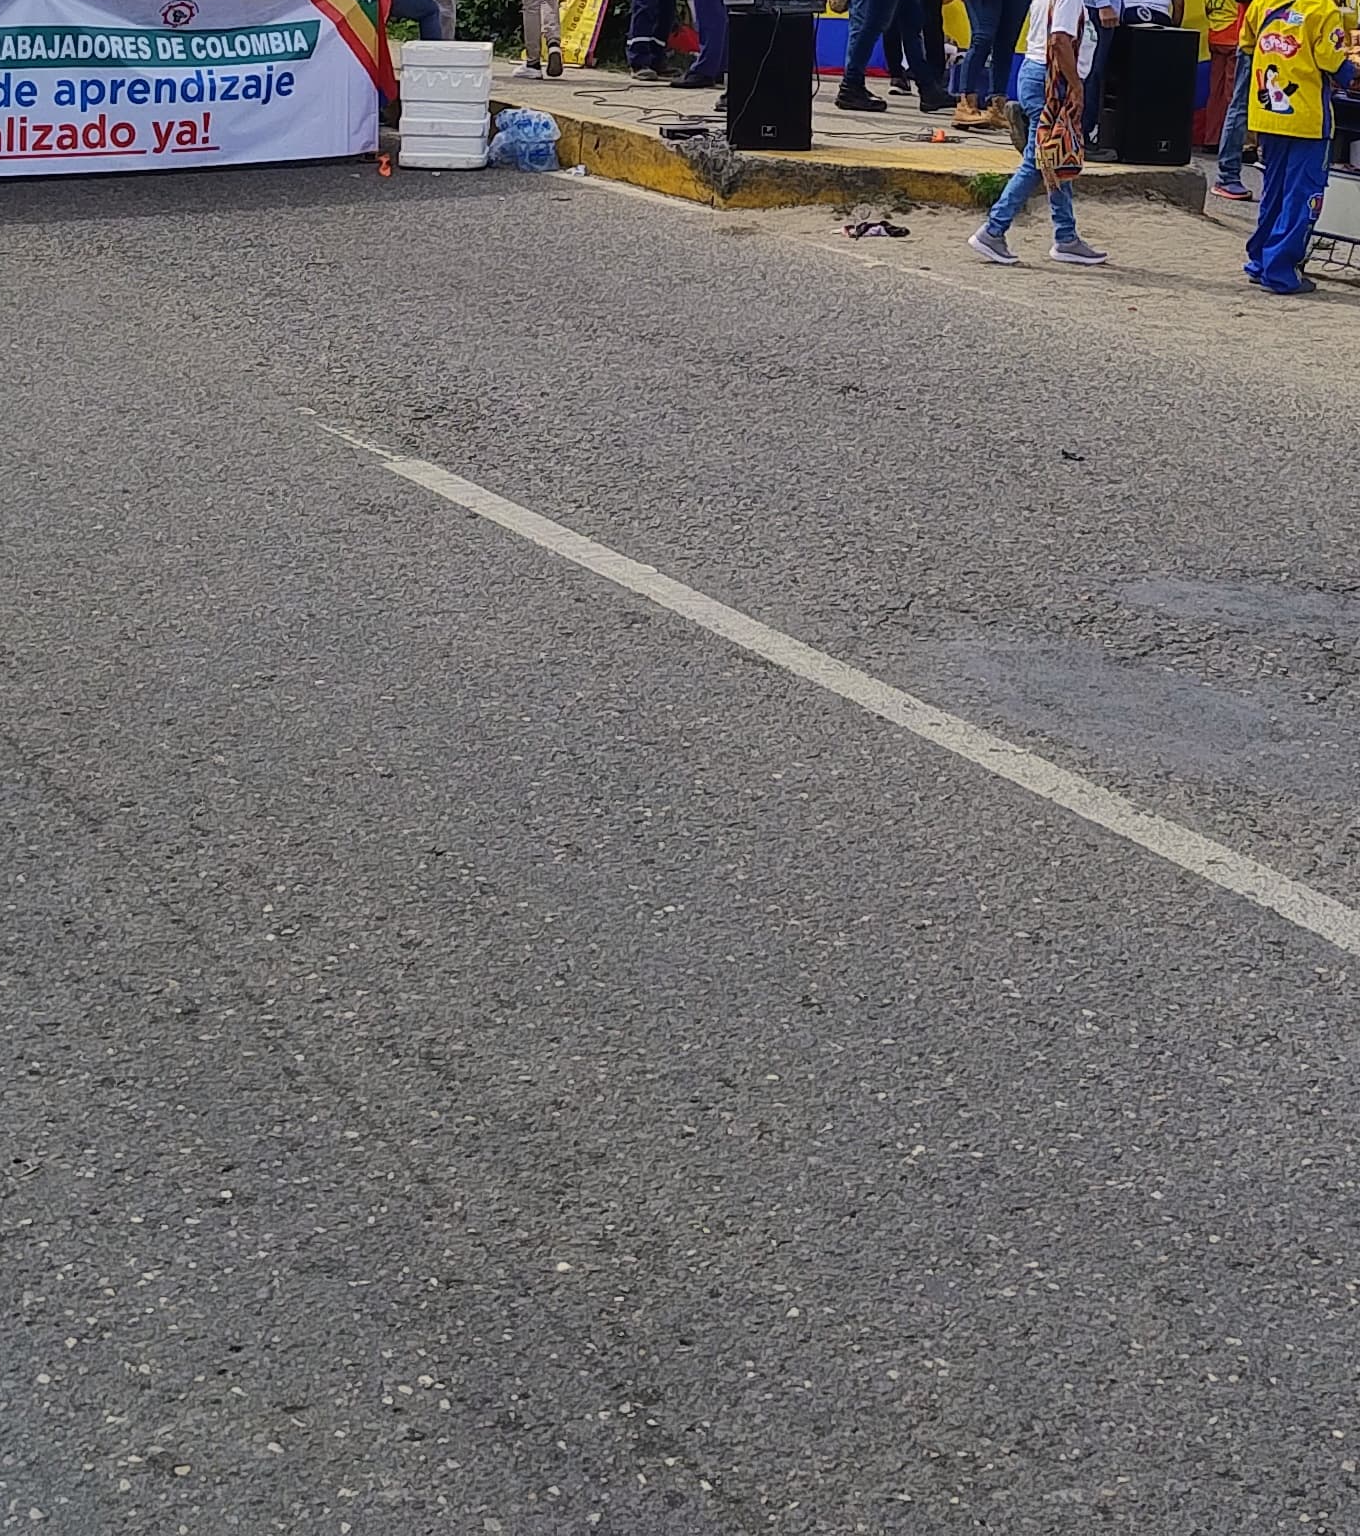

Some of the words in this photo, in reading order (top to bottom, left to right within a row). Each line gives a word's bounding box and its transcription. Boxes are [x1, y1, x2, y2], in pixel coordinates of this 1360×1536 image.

[156, 37, 187, 60] DE
[190, 29, 309, 59] COLOMBIA
[53, 65, 295, 113] aprendizaje
[152, 112, 211, 154] ya!
